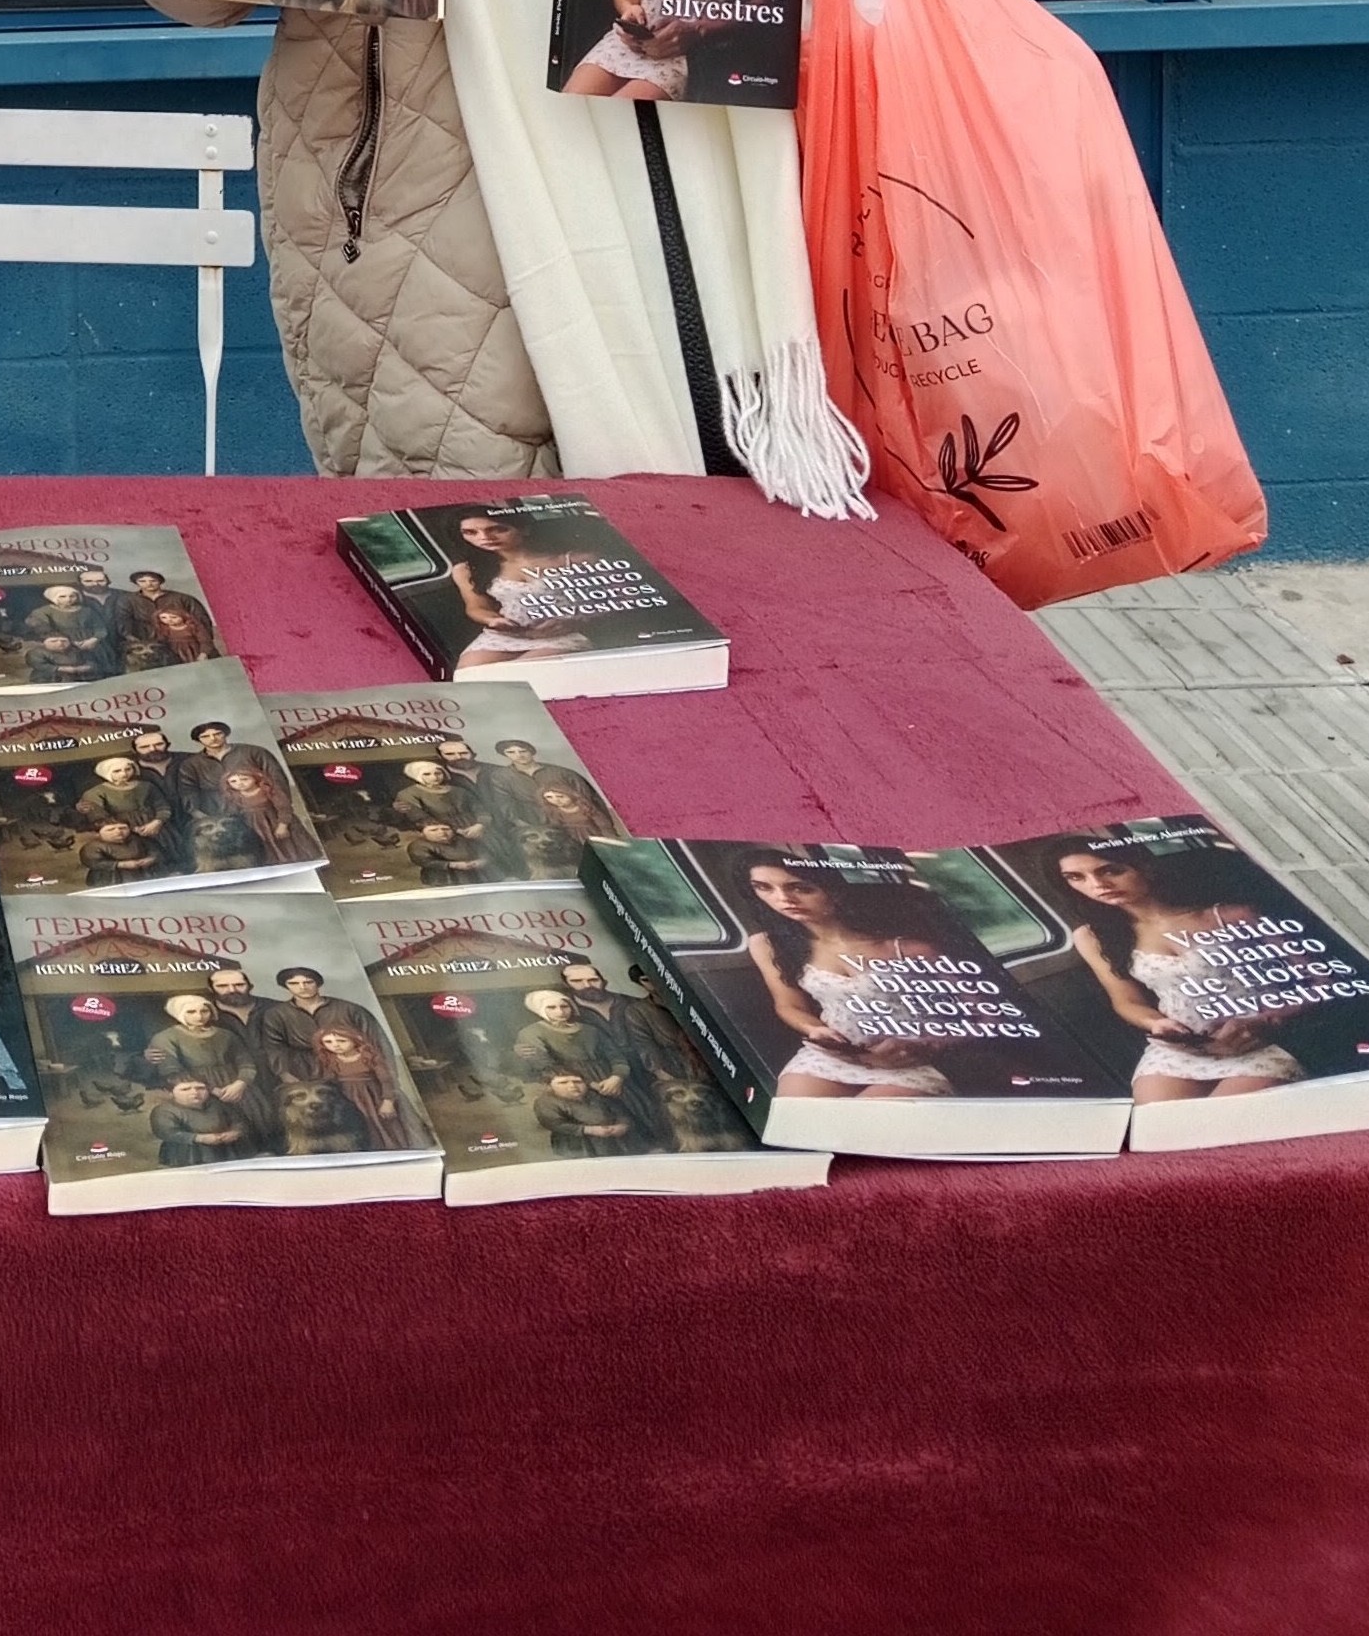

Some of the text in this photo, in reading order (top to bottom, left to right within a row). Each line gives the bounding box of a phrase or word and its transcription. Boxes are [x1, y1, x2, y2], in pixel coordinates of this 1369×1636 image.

[910, 303, 994, 353] BAG
[910, 359, 982, 387] RECYCLE
[30, 564, 89, 575] ALARCÓN
[521, 559, 631, 580] Vestido
[543, 570, 643, 591] blanco
[520, 583, 657, 608] de flores
[526, 595, 668, 620] silvestres
[270, 698, 461, 723] TERRITORIO
[30, 738, 76, 752] PÉREZ
[77, 727, 144, 747] ALARCÓN
[286, 733, 447, 752] KEVIN PÉREZ ALARCÓN
[1088, 838, 1124, 851] Kevin
[783, 858, 818, 868] Kevin
[25, 914, 246, 936] TERRITORIO
[367, 908, 587, 939] TERRITORIO
[1163, 916, 1304, 949] Vestido
[1197, 938, 1326, 967] blanco
[35, 959, 221, 976] KEVIN PÉREZ ALARCÓN
[388, 954, 571, 977] KEVIN PÉREZ ALARCÓN
[839, 954, 982, 975] Vestido
[871, 973, 1000, 995] blanco
[1180, 959, 1354, 997] de flores
[846, 994, 1023, 1017] de flores
[1195, 978, 1369, 1021] silvestres
[856, 1015, 1041, 1038] silvestres
